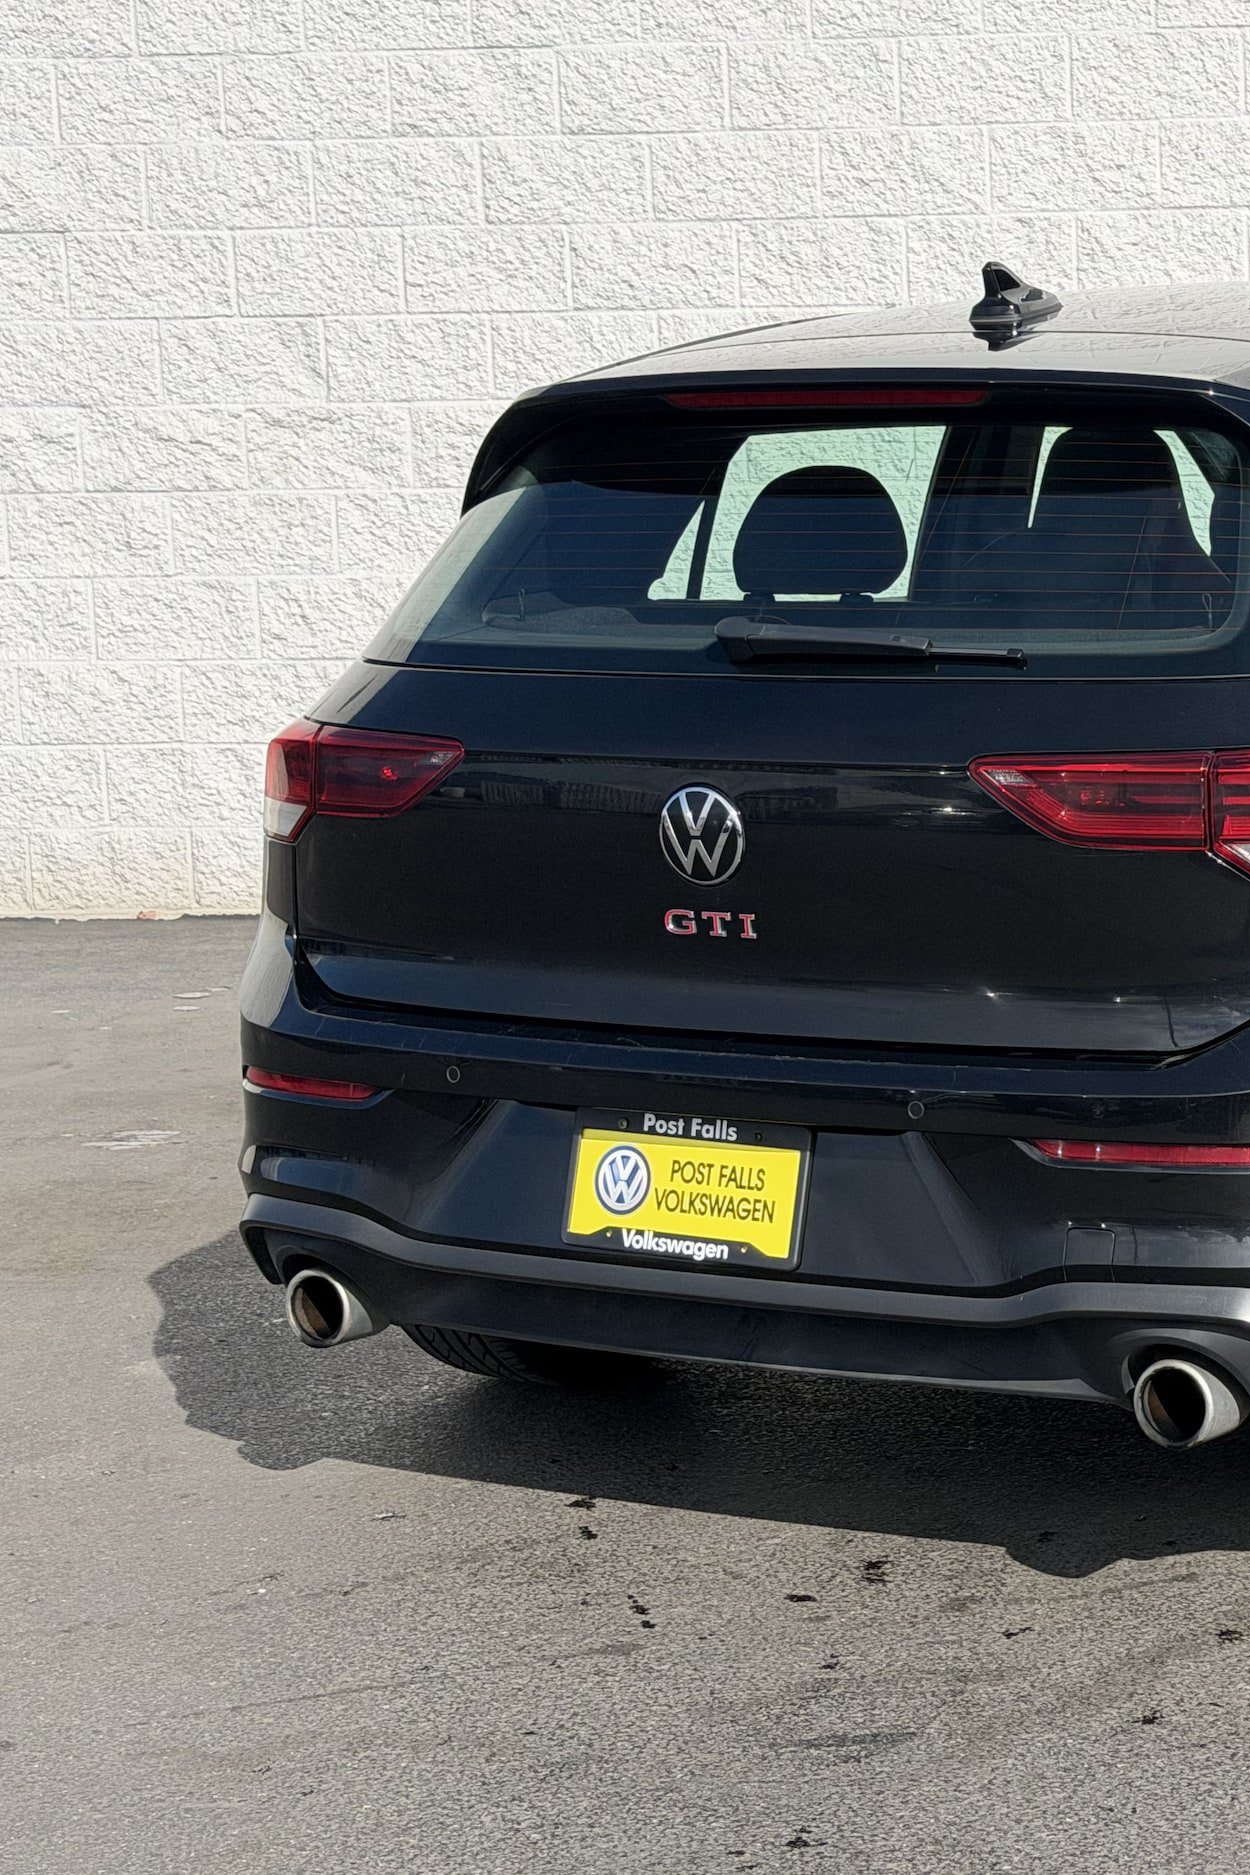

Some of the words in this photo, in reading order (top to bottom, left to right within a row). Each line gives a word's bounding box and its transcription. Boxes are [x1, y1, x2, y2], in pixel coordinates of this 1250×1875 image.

[664, 908, 757, 939] GTI
[644, 1113, 684, 1136] Post
[691, 1118, 738, 1141] Falls
[670, 1159, 714, 1187] POST
[718, 1165, 766, 1191] FALLS
[654, 1188, 775, 1223] VOLKSWAGEN
[622, 1228, 729, 1260] Volkswagen
